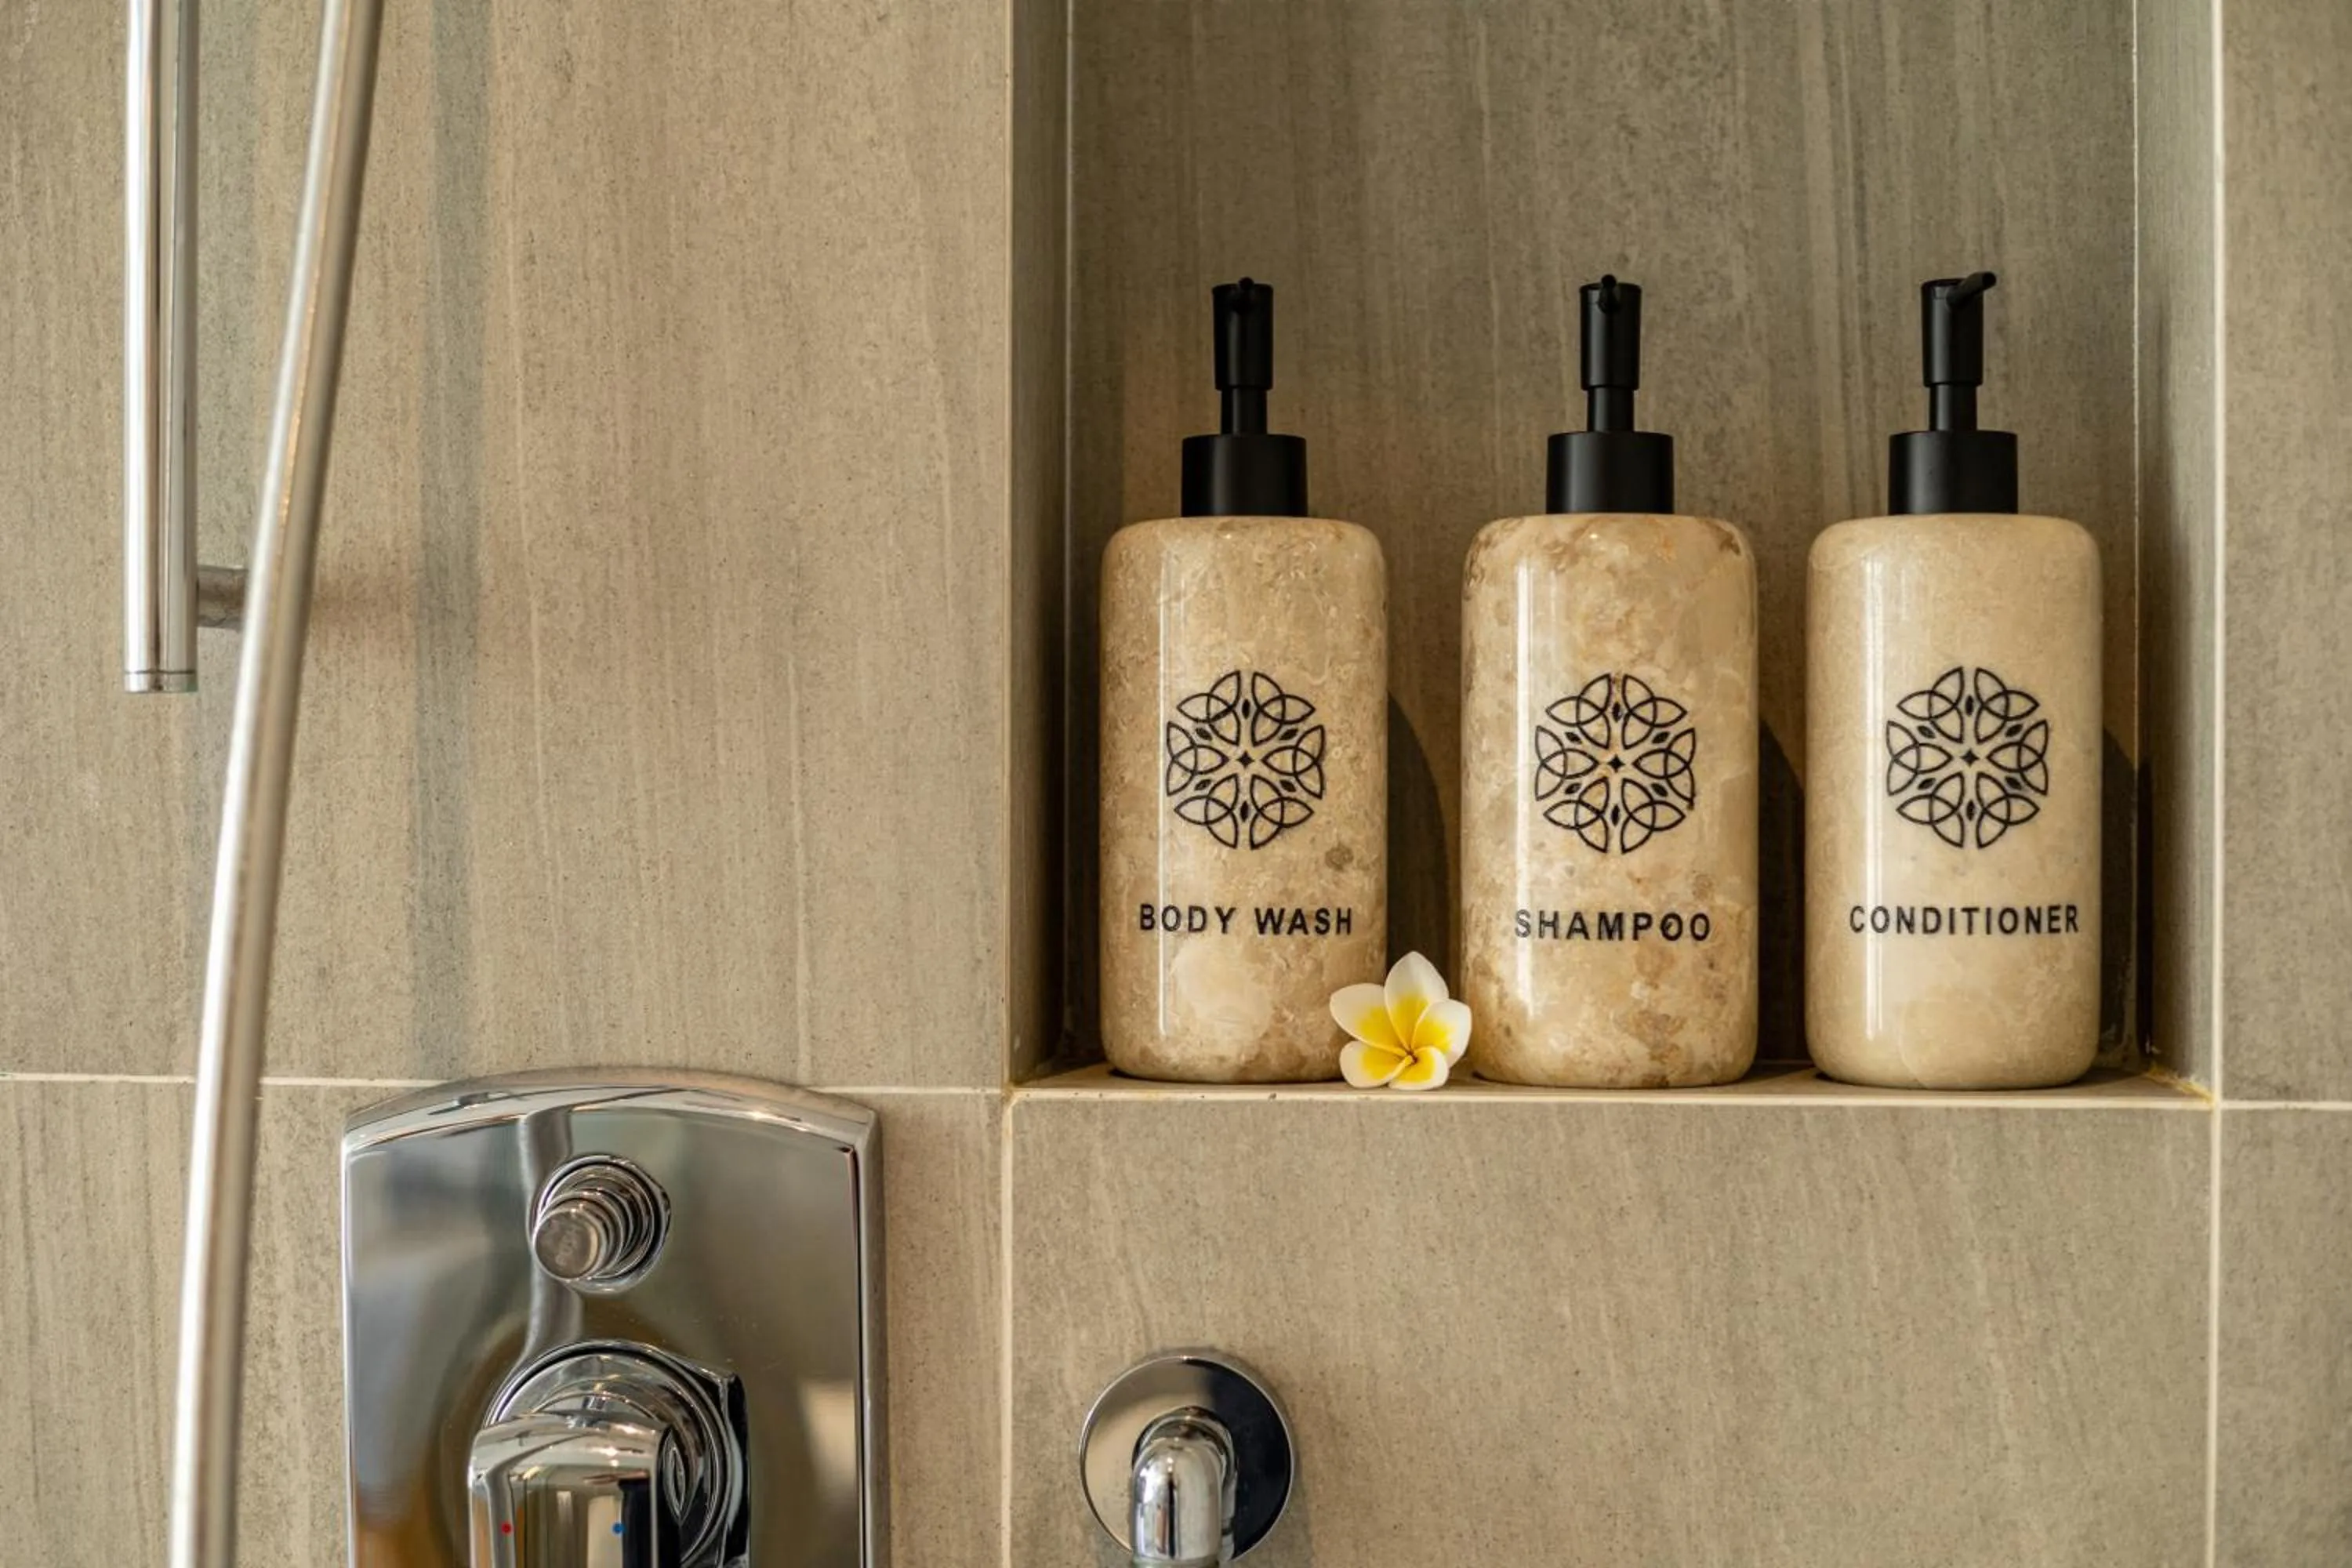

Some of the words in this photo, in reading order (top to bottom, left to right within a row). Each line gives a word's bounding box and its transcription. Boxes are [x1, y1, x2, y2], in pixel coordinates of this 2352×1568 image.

[1139, 903, 1236, 934] BODY
[1254, 907, 1352, 935] WASH
[1515, 909, 1711, 942] SHAMPOO
[1849, 904, 2079, 935] CONDITIONER
